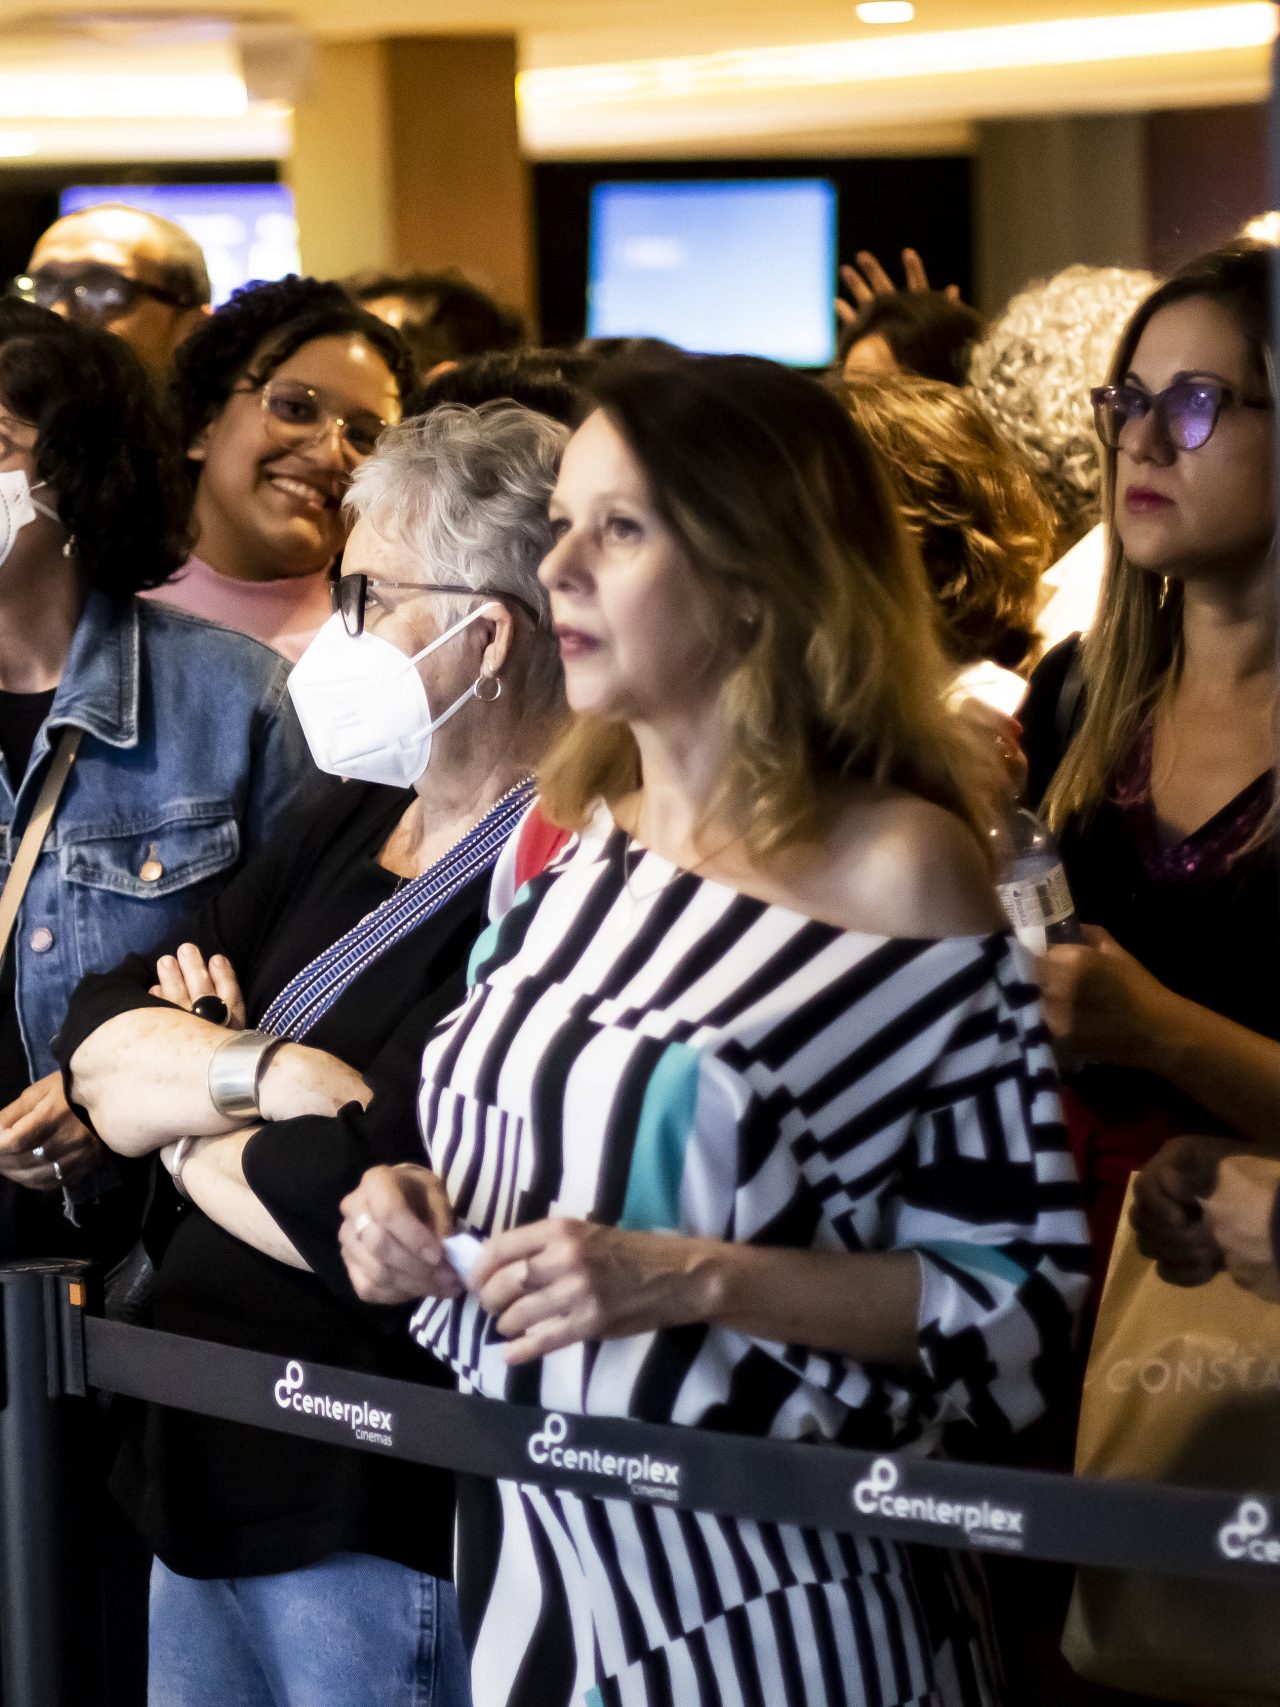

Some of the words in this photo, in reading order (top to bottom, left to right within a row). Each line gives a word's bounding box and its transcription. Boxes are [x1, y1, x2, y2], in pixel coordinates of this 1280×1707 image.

[292, 1392, 392, 1431] centerplex
[355, 1429, 392, 1447] cinemas
[550, 1444, 680, 1486] centerplex
[880, 1492, 1024, 1535] centerplex
